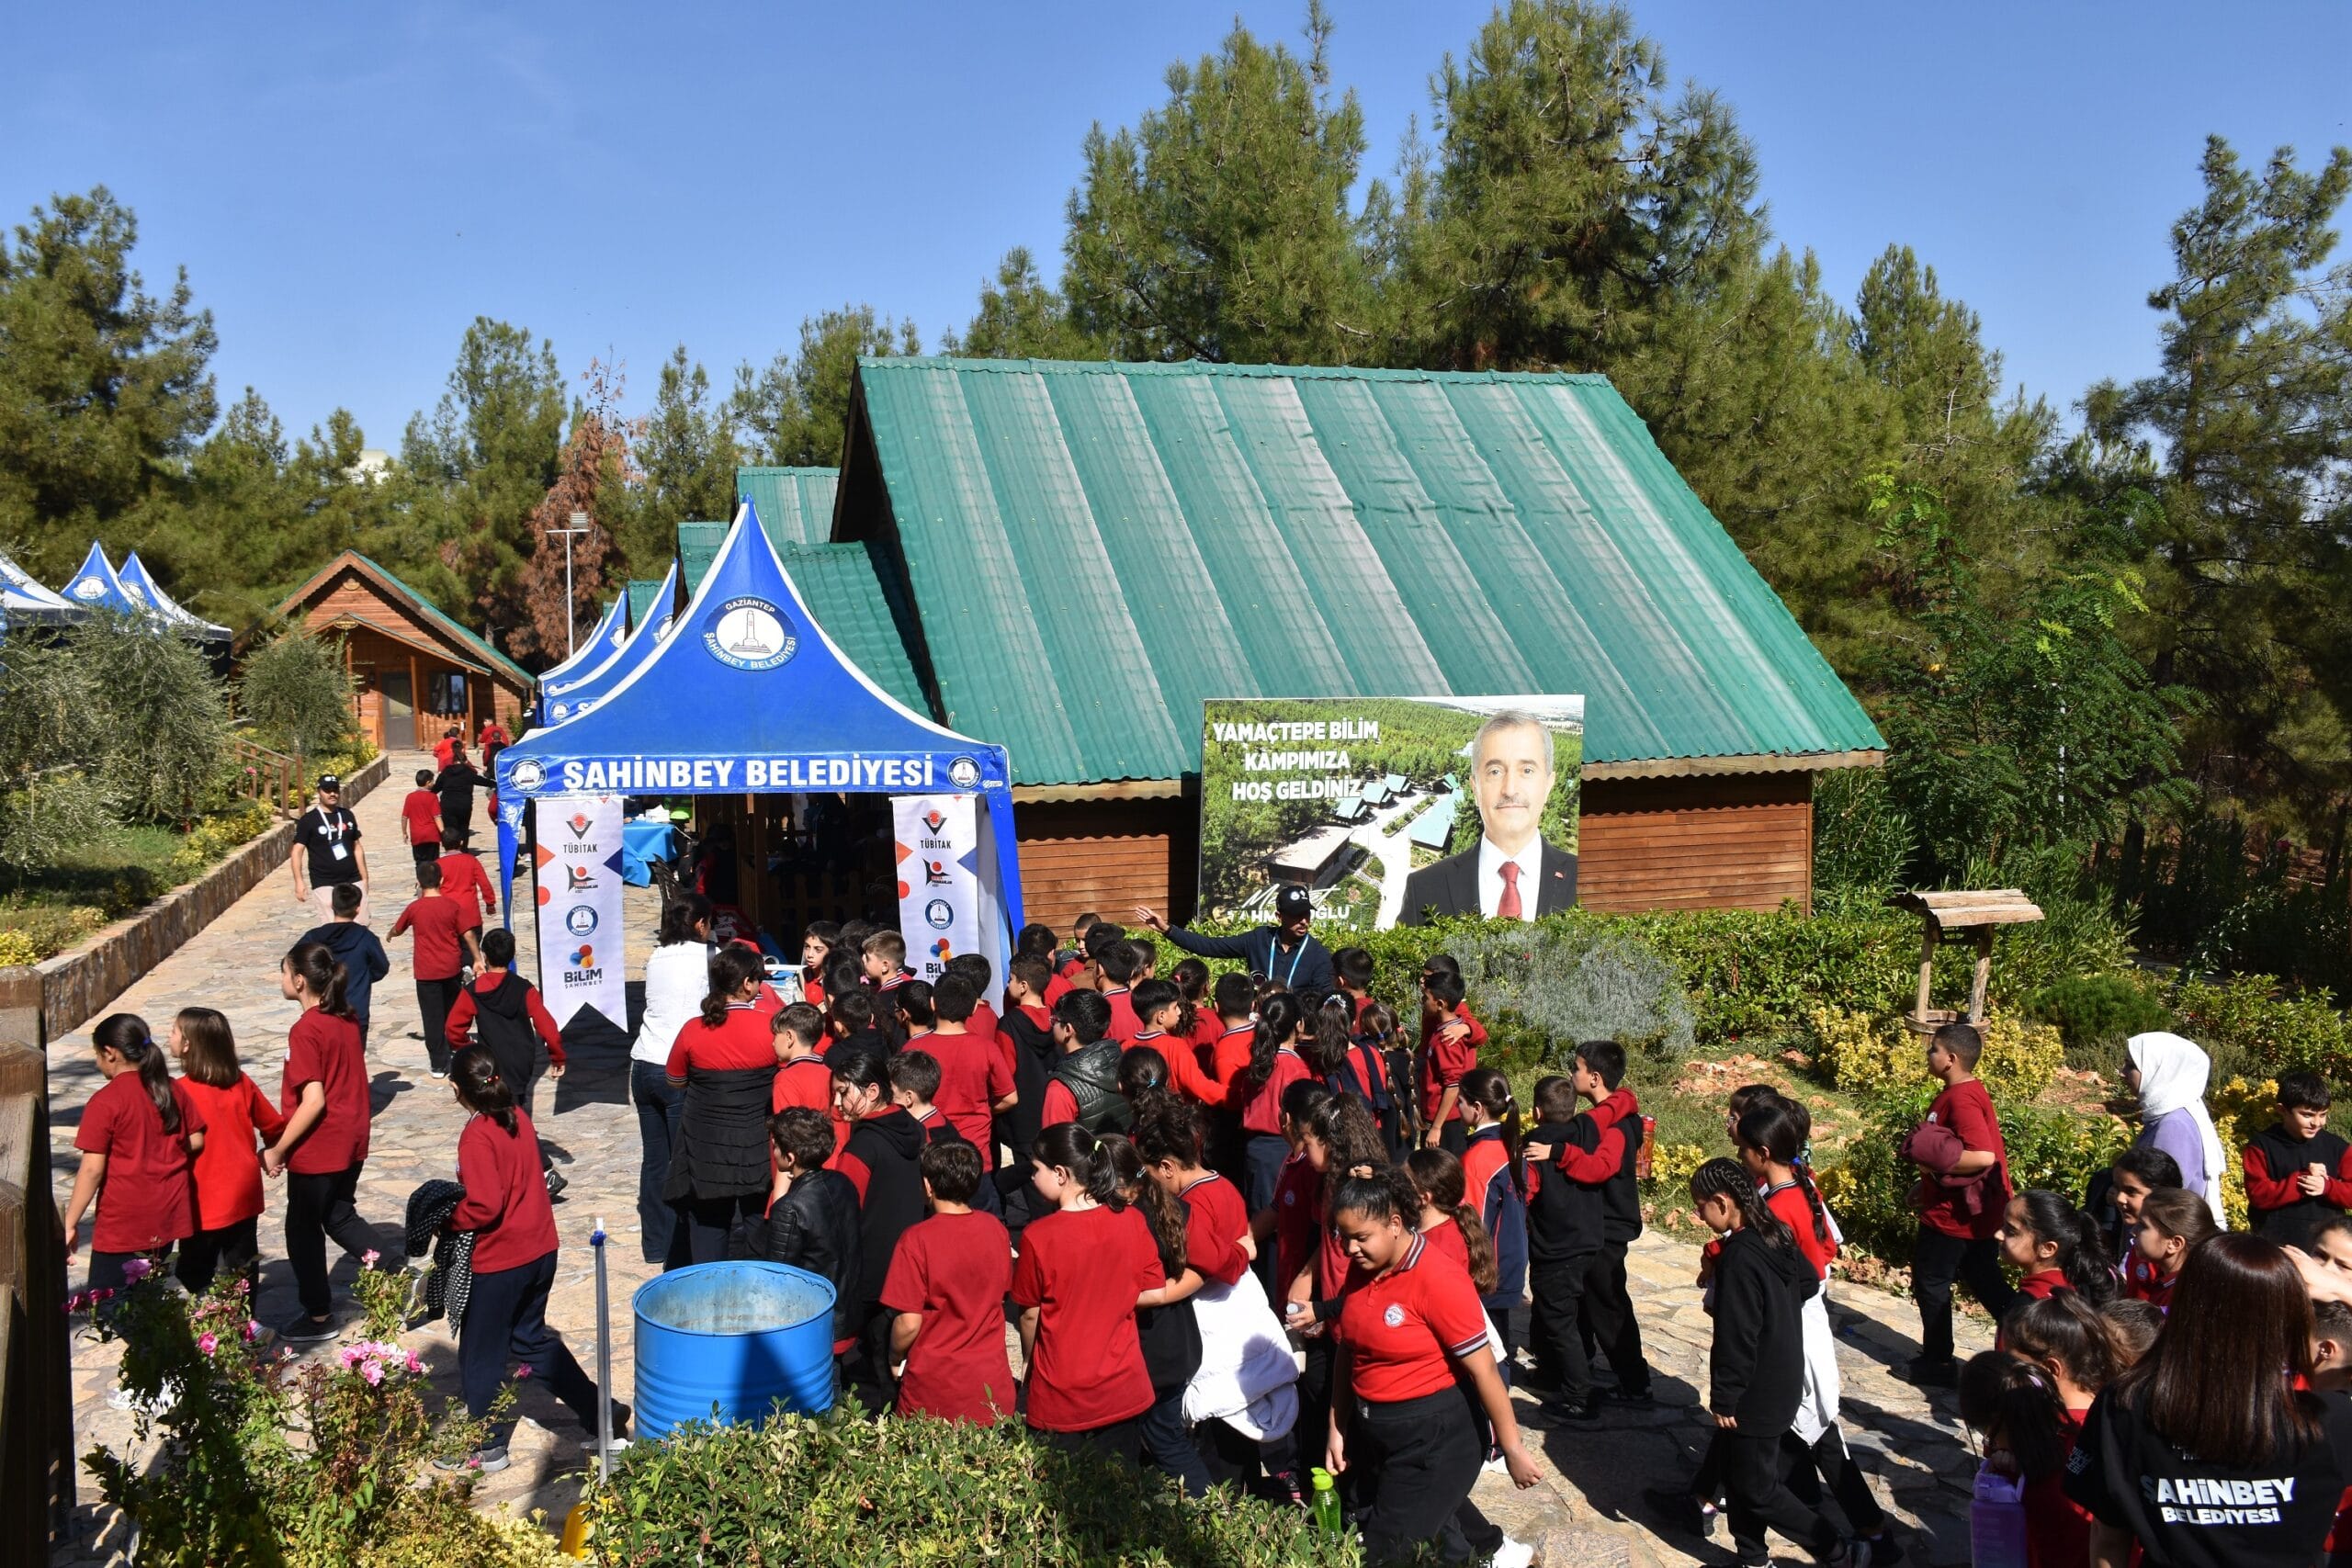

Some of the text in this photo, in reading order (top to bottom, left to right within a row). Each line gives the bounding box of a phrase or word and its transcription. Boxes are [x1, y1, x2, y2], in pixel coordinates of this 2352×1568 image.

[725, 597, 775, 613] GAZİANTEP
[1212, 716, 1378, 745] YAMAÇTEPE BİLİM
[746, 753, 933, 786] BELEDİYESİ
[1245, 750, 1351, 772] KAMPIMIZA
[1232, 775, 1362, 804] HOŞ GELDİNİZ
[563, 842, 598, 854] TÜBİTAK
[920, 838, 952, 850] TÜBİTAK
